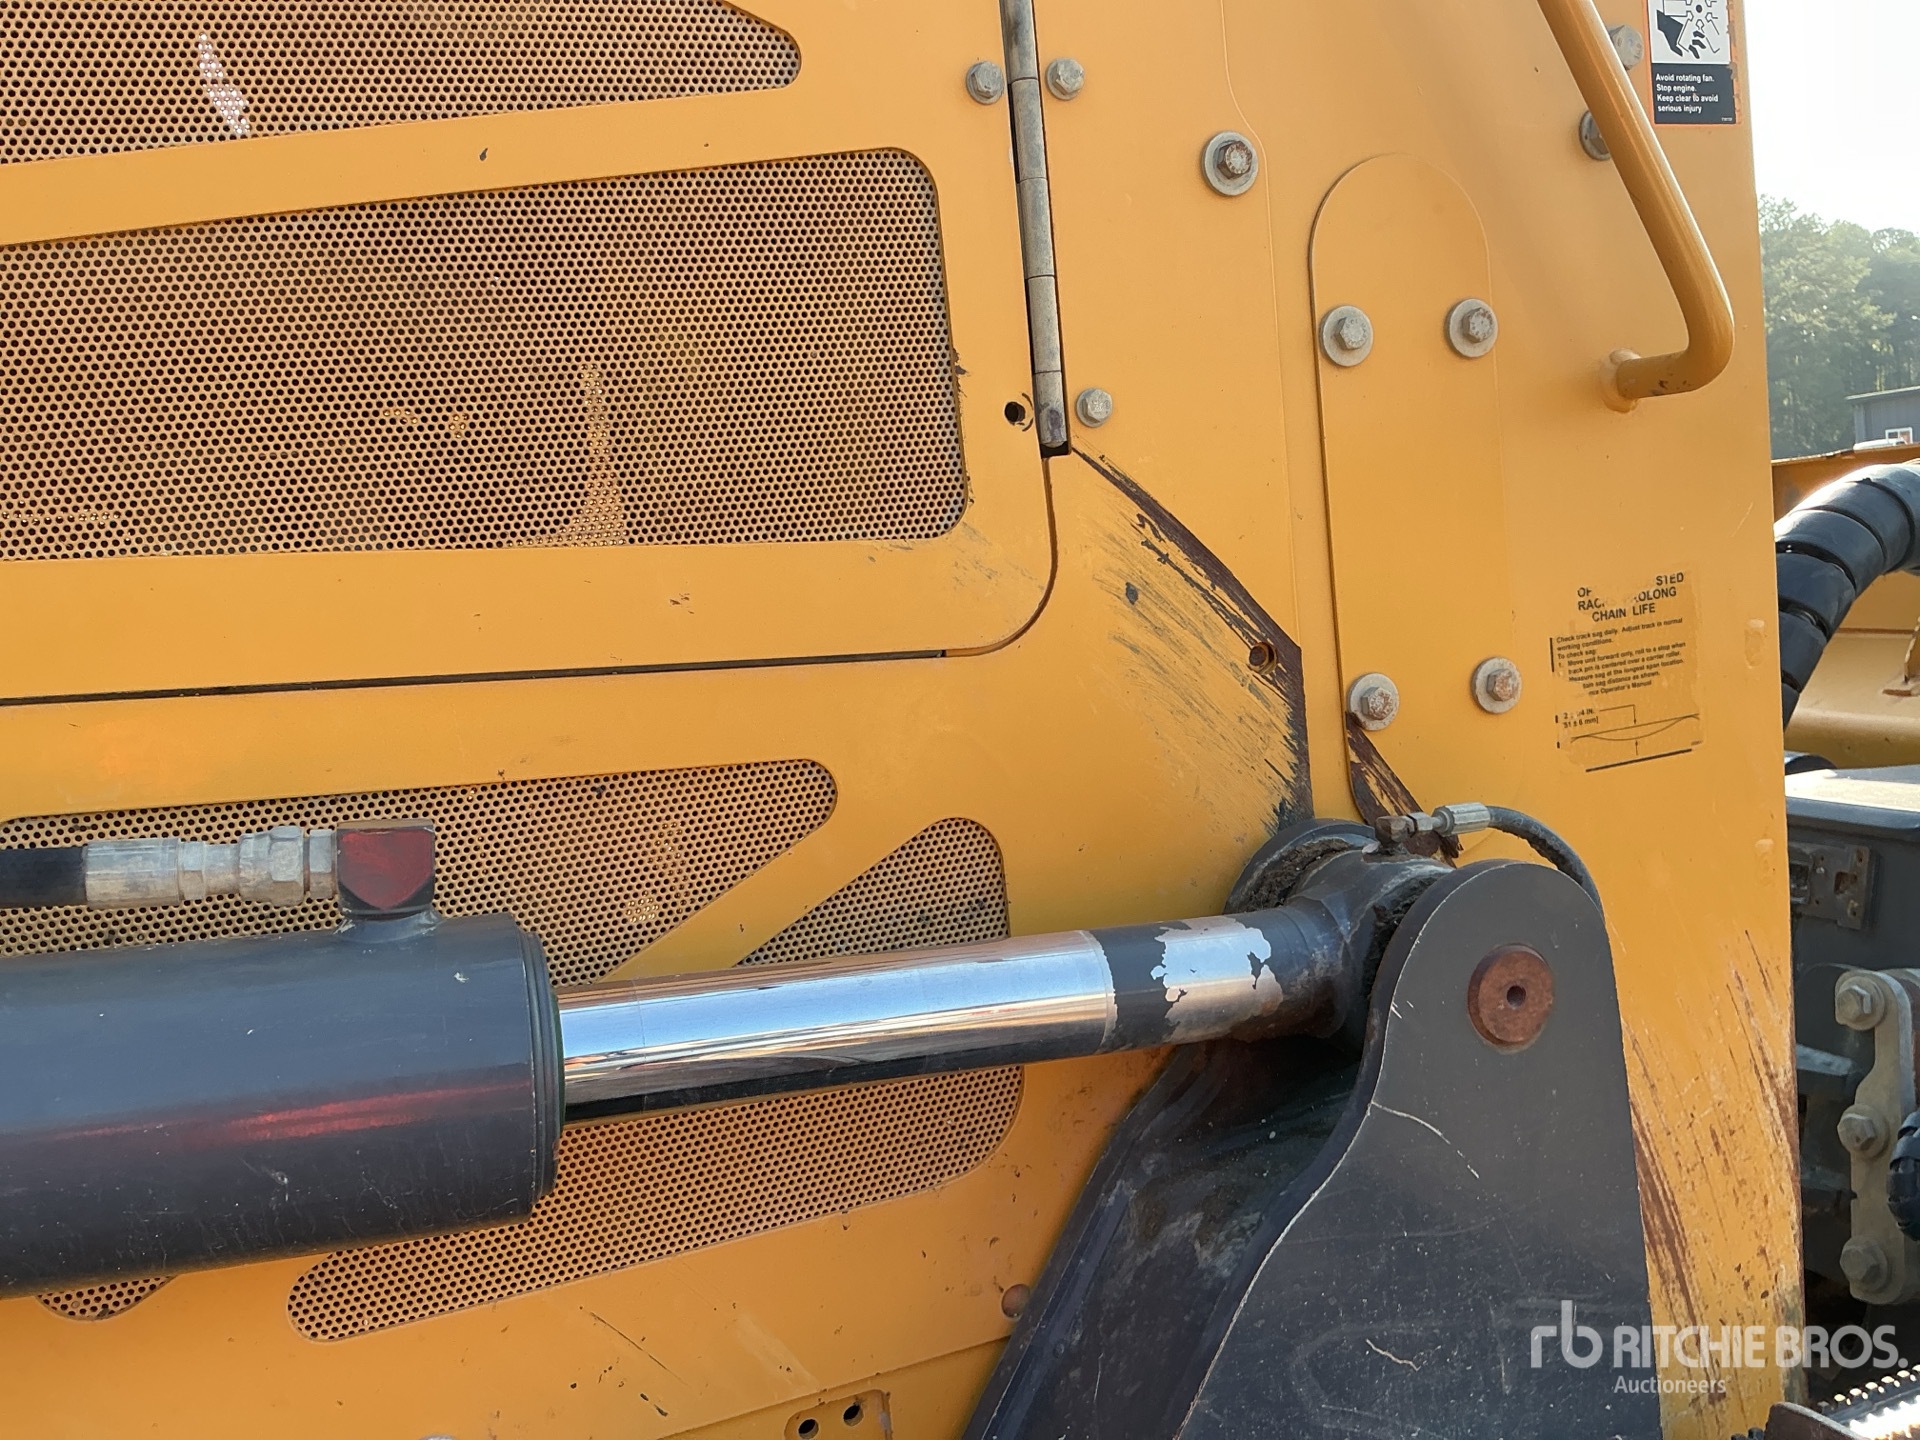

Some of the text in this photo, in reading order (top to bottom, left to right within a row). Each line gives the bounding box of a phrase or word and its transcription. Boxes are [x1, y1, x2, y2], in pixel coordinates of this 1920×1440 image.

[1656, 74, 1674, 82] Avoid
[1676, 74, 1701, 83] rotating
[1656, 84, 1697, 93] Stop engine.
[1657, 94, 1674, 103] Keep
[1692, 94, 1700, 102] to
[1684, 105, 1702, 114] injury
[1634, 586, 1676, 603] OLONG
[1592, 602, 1656, 622] CHAIN LIFE
[1556, 635, 1575, 643] Check
[1597, 653, 1619, 661] forward
[1602, 660, 1626, 669] centered
[1624, 665, 1644, 673] longest
[1600, 684, 1630, 694] Operator's
[1632, 680, 1652, 688] Manual
